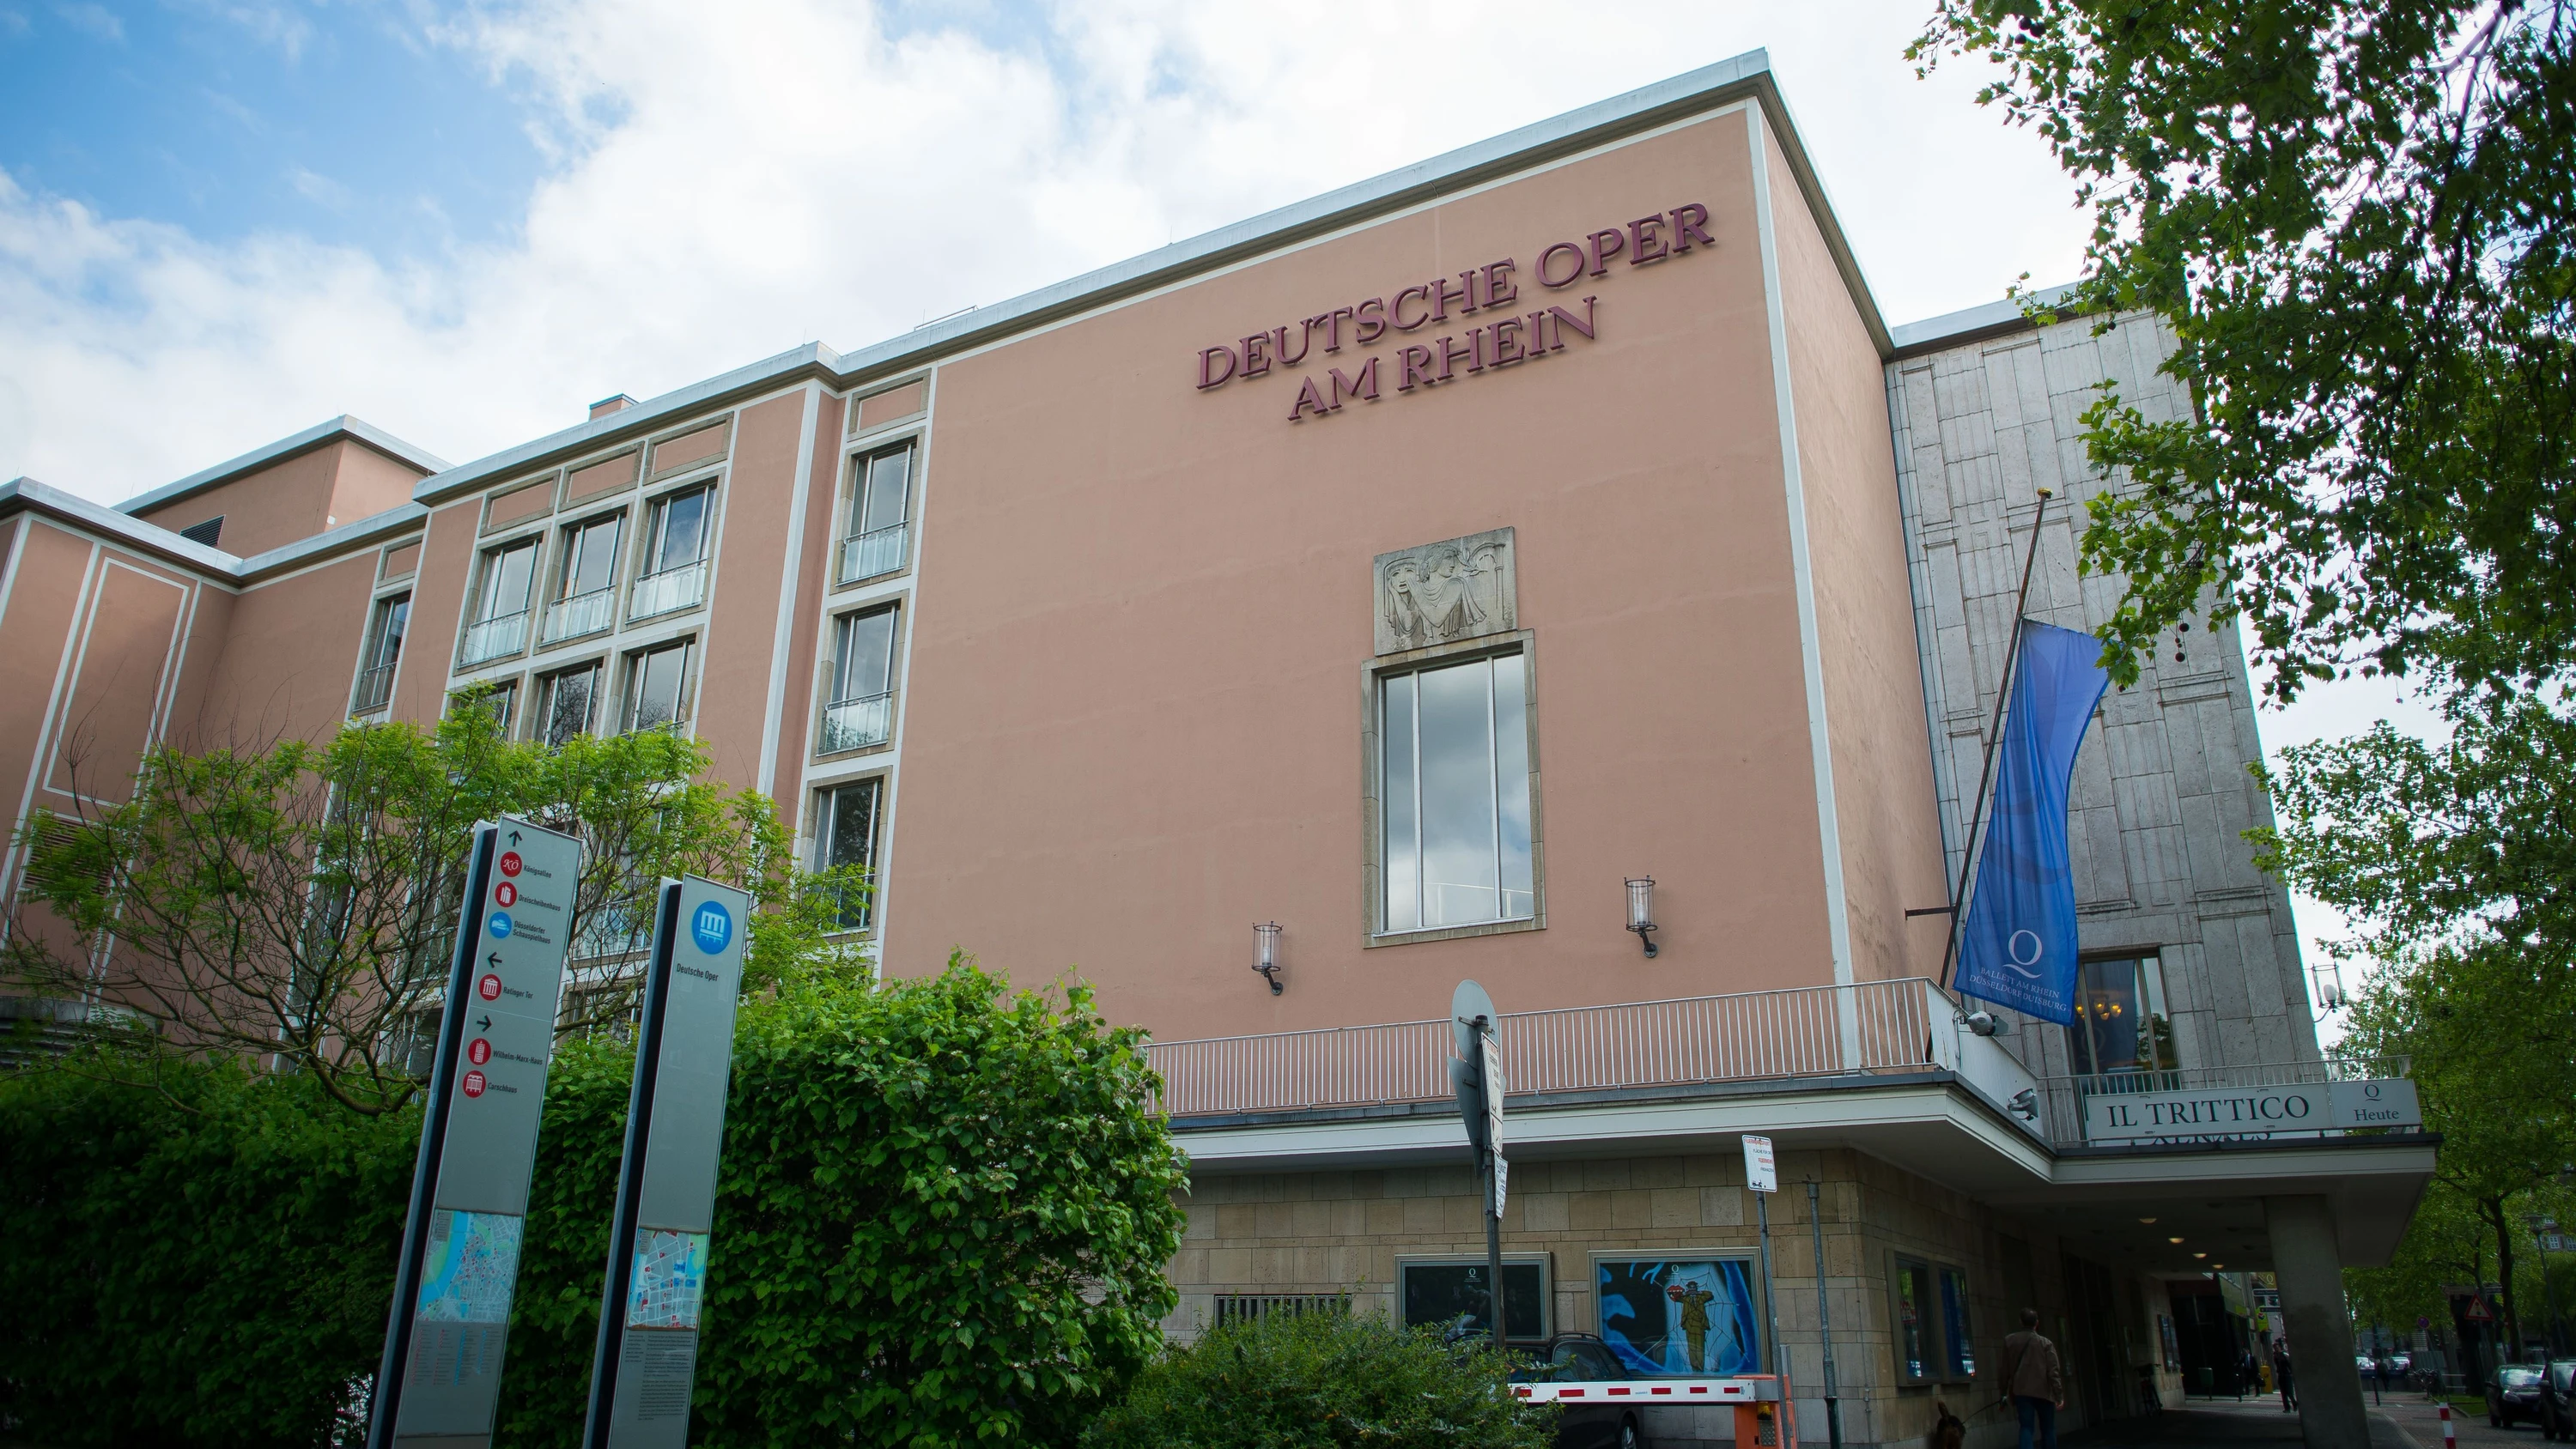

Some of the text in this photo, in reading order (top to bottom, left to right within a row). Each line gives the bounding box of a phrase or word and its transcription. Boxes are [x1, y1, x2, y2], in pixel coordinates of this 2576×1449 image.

[1196, 203, 1716, 390] DEUTSCHE OPER
[1288, 295, 1597, 421] AM RHEIN
[523, 864, 552, 878] Königsallee
[519, 894, 562, 912] Dreischeibenhaus
[513, 929, 551, 944] Schauspielhaus
[514, 920, 546, 935] Düsseldorfer
[2002, 929, 2044, 979] Q
[676, 962, 719, 982] Deutsche Oper
[1980, 967, 2060, 999] BALLETT AM RHEIN
[503, 986, 534, 999] Ratinger Tor
[1969, 974, 2068, 1012] DÜSSELDORF DUISBURG
[493, 1050, 544, 1065] Wilhelm-Marx-Haus
[487, 1082, 518, 1094] Carschhaus
[2364, 1083, 2383, 1102] Q
[2106, 1095, 2311, 1128] IL TRITTICO
[2354, 1108, 2400, 1122] Heute
